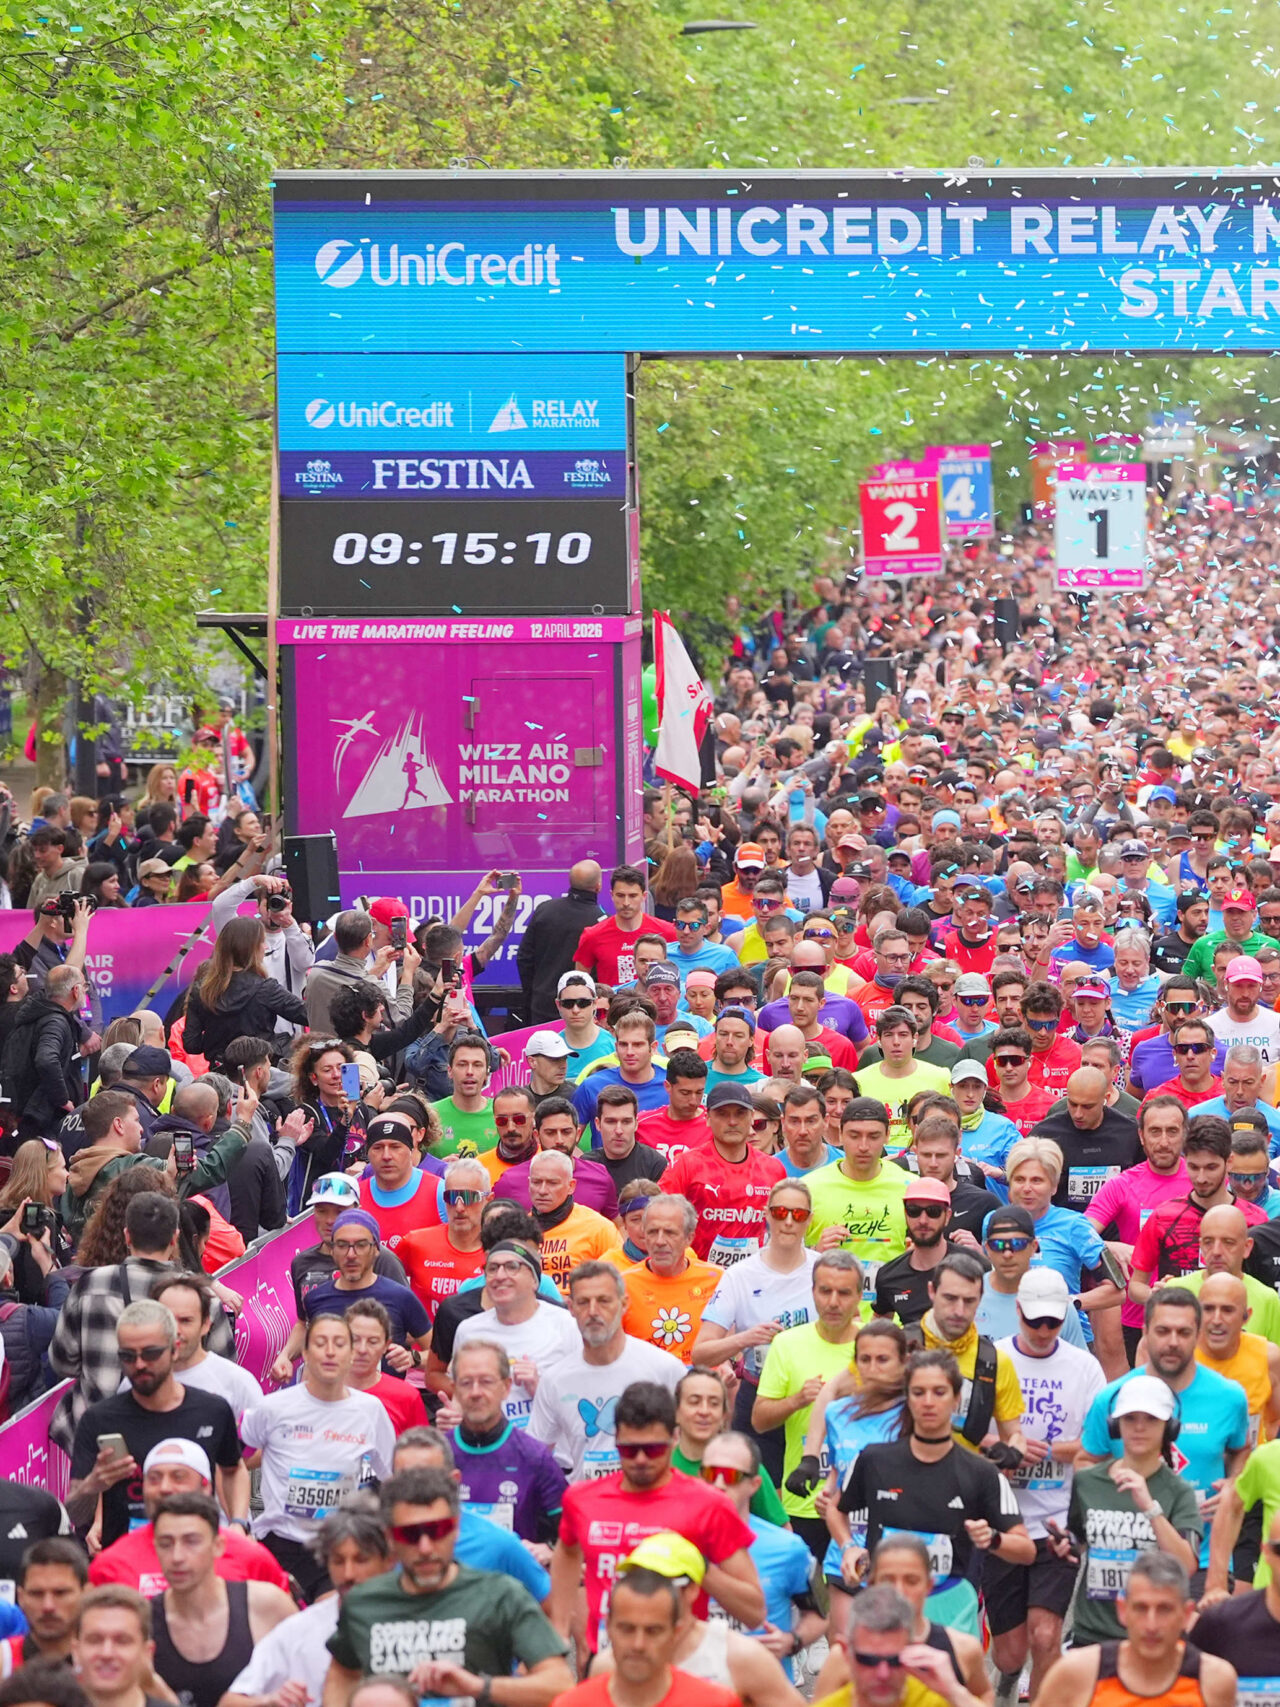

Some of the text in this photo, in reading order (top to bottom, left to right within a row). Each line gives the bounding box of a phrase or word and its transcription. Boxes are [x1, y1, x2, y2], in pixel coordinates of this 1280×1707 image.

[613, 205, 987, 258] UNICREDIT
[1011, 203, 1230, 255] RELAY
[371, 241, 561, 288] UniCredit
[338, 400, 454, 429] UniCredit
[532, 399, 599, 418] RELAY
[532, 418, 600, 429] MARATHON
[294, 471, 344, 484] FESTINA
[372, 458, 535, 490] FESTINA
[562, 470, 611, 483] FESTINA
[867, 485, 916, 500] WAVE
[945, 477, 976, 518] 4
[1069, 487, 1120, 501] WAVE
[882, 501, 920, 552] 2
[1088, 508, 1109, 558] 1
[332, 531, 593, 565] 09:15:10
[293, 624, 515, 640] LIVE THE MARATHON FEELING
[530, 623, 603, 639] 12 APRIL 2026
[458, 743, 569, 761] WIZZ AIR
[458, 763, 571, 785] MILANO
[459, 787, 570, 803] MARATHON
[1246, 1035, 1270, 1047] FOR
[429, 1260, 455, 1270] UniCredit
[1023, 1378, 1063, 1392] TEAM
[296, 1486, 341, 1508] 3596A
